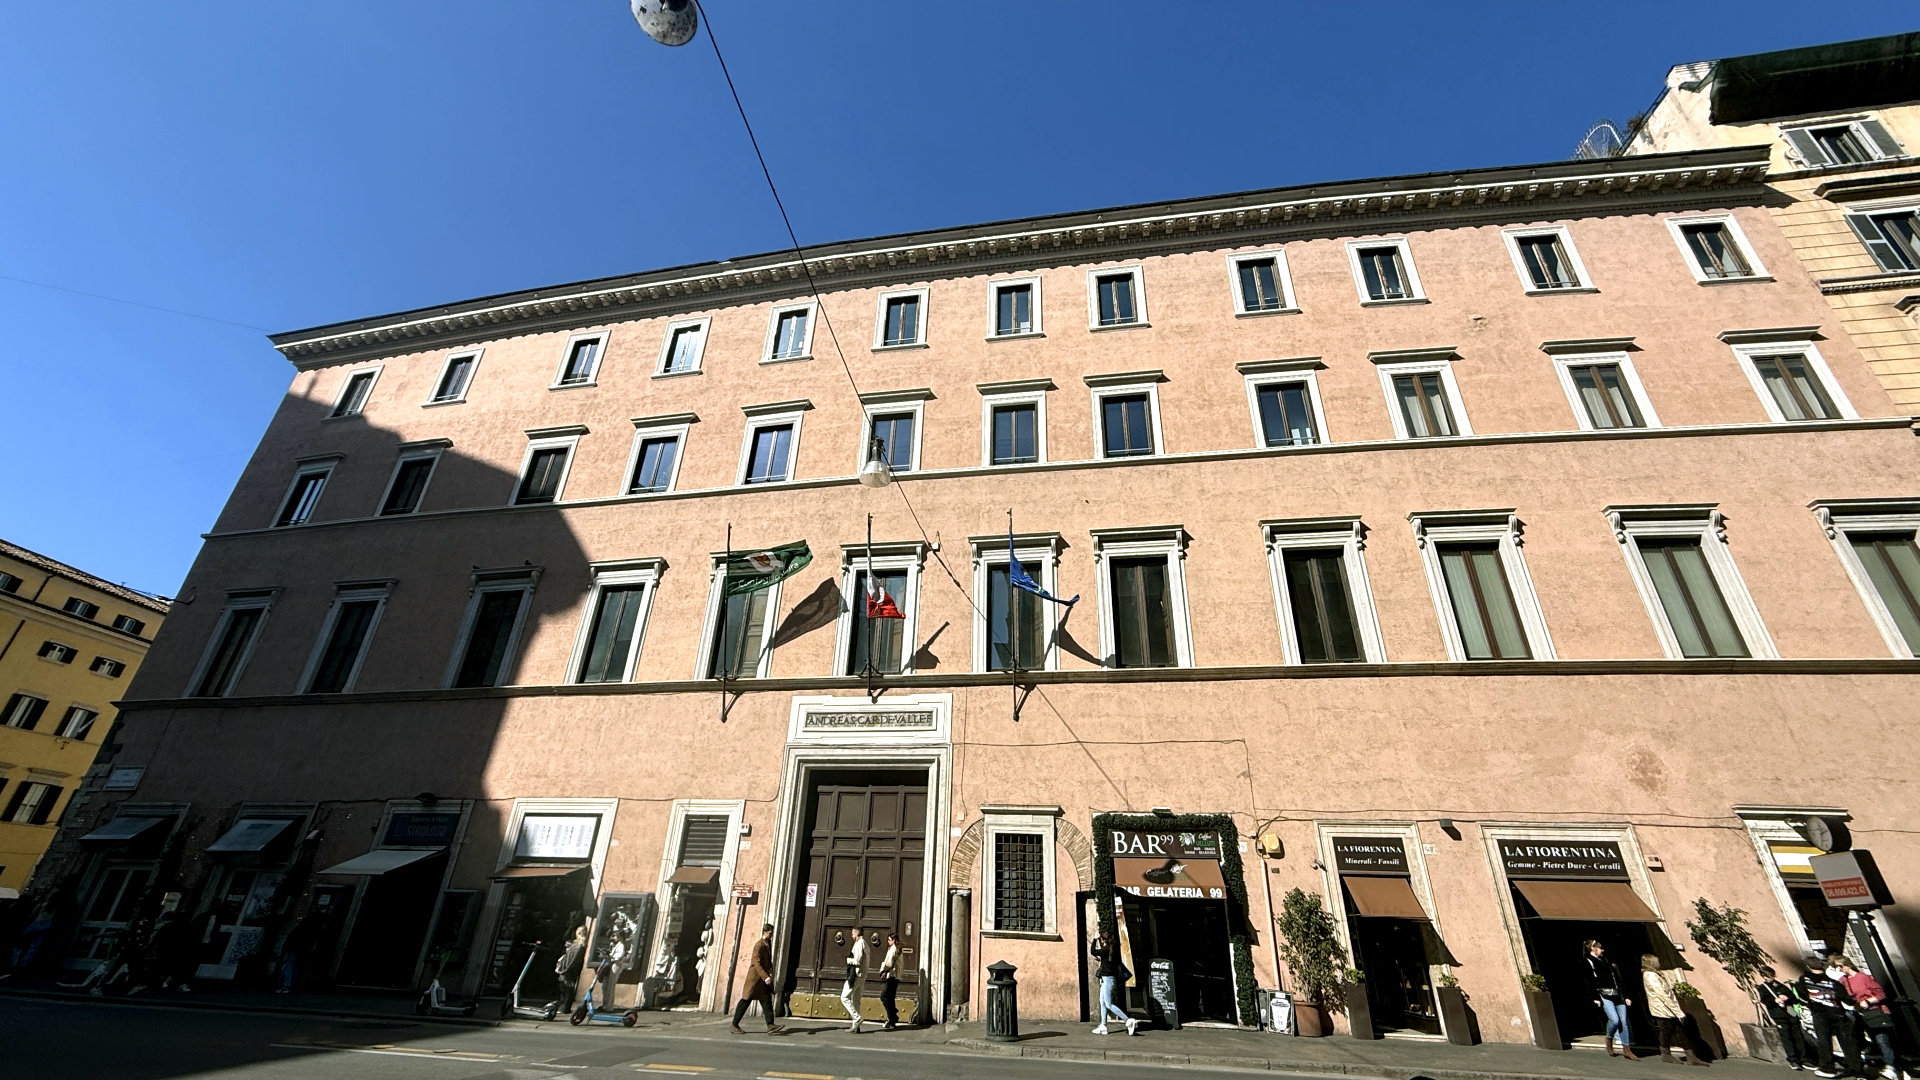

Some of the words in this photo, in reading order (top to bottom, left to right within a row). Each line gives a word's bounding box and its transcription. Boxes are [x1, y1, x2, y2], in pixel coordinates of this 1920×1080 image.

[1112, 831, 1166, 854] BAR
[1160, 834, 1174, 845] 99
[1349, 845, 1402, 853] FIORENTINA
[1504, 846, 1524, 857] LA
[1525, 846, 1617, 858] FIORENTINA
[1344, 857, 1372, 865] Minerali
[1507, 861, 1536, 869] Gemme
[1543, 861, 1566, 869] Pietre
[1567, 862, 1586, 870] Dure
[1593, 862, 1621, 870] Coralli
[1147, 886, 1203, 898] GELATERIA
[1210, 888, 1223, 898] 99
